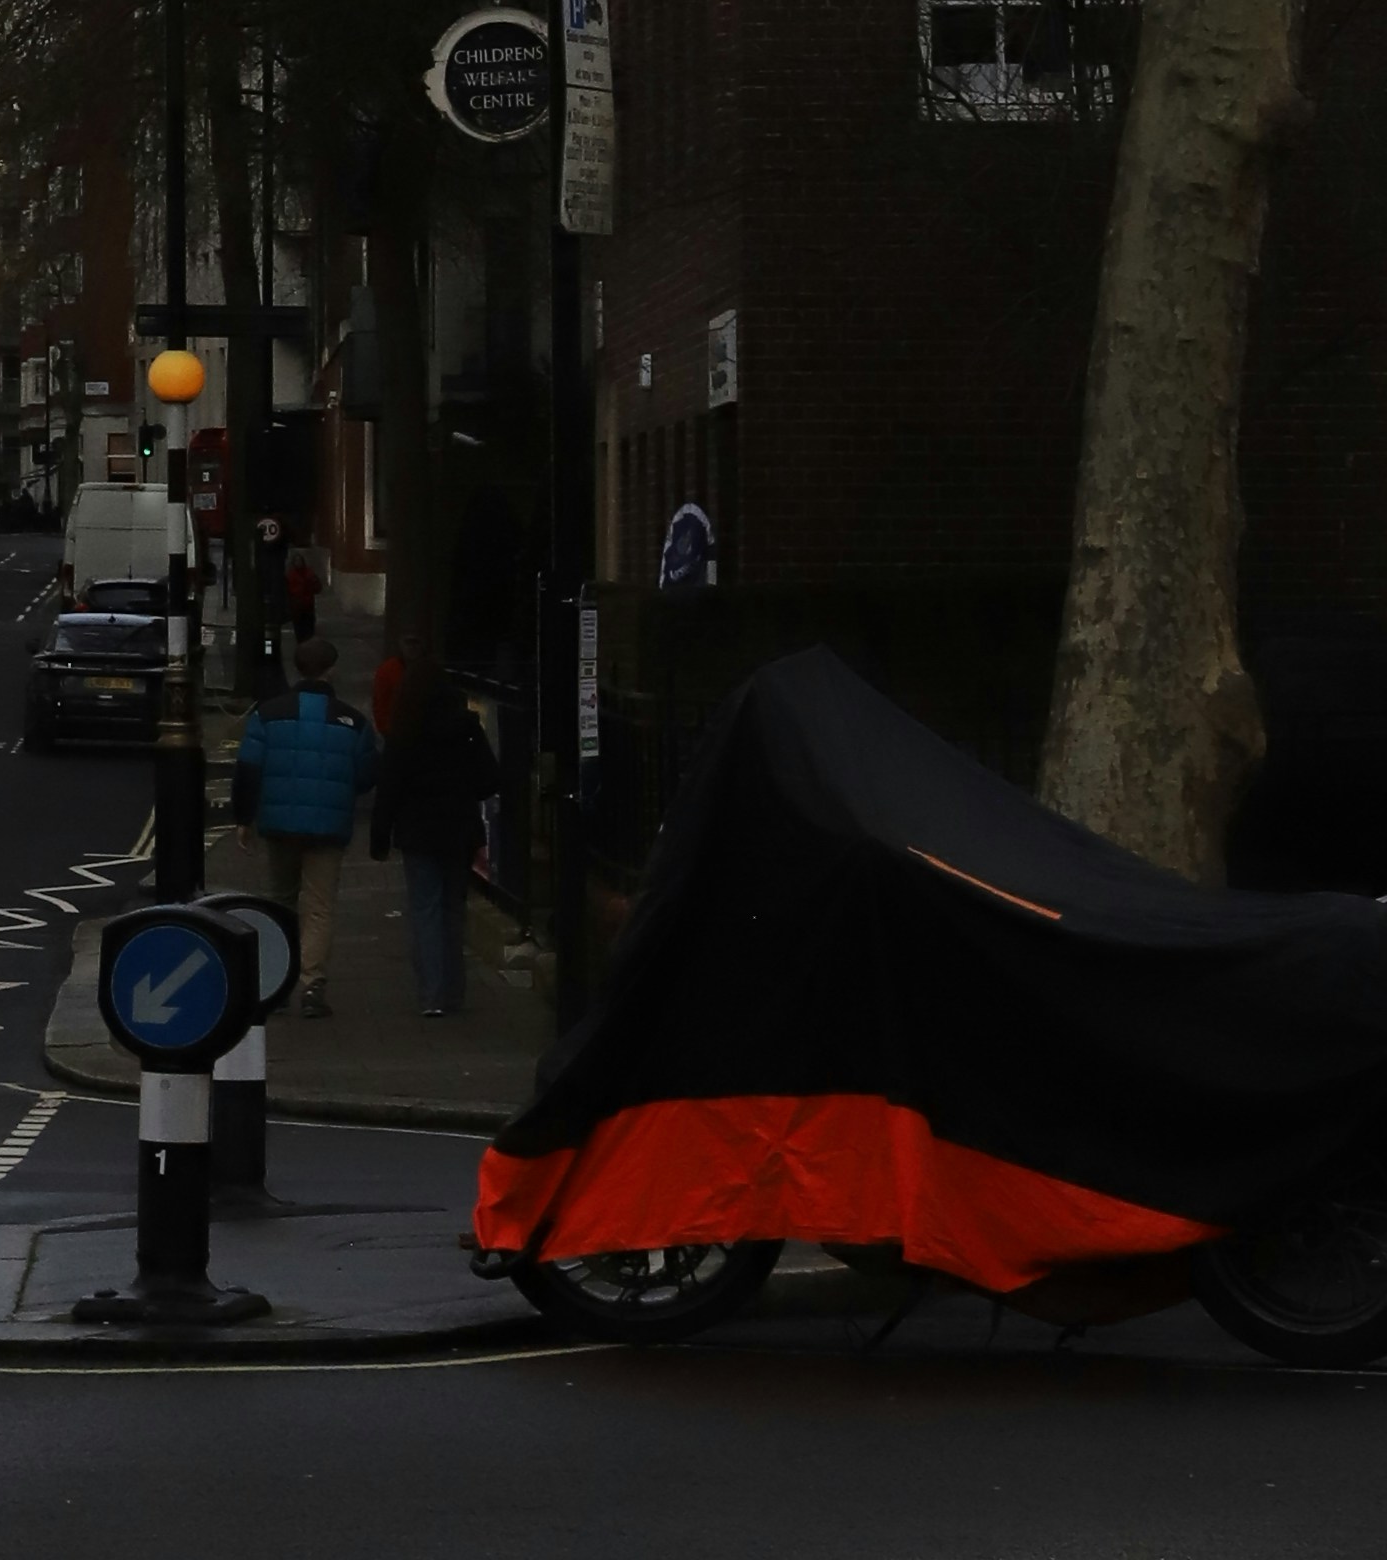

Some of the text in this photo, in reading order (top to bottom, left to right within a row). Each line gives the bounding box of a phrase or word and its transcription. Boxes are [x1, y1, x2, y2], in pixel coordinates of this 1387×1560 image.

[454, 45, 543, 65] CHILDRENS
[469, 92, 536, 110] CENTRE
[154, 1148, 167, 1176] 1
